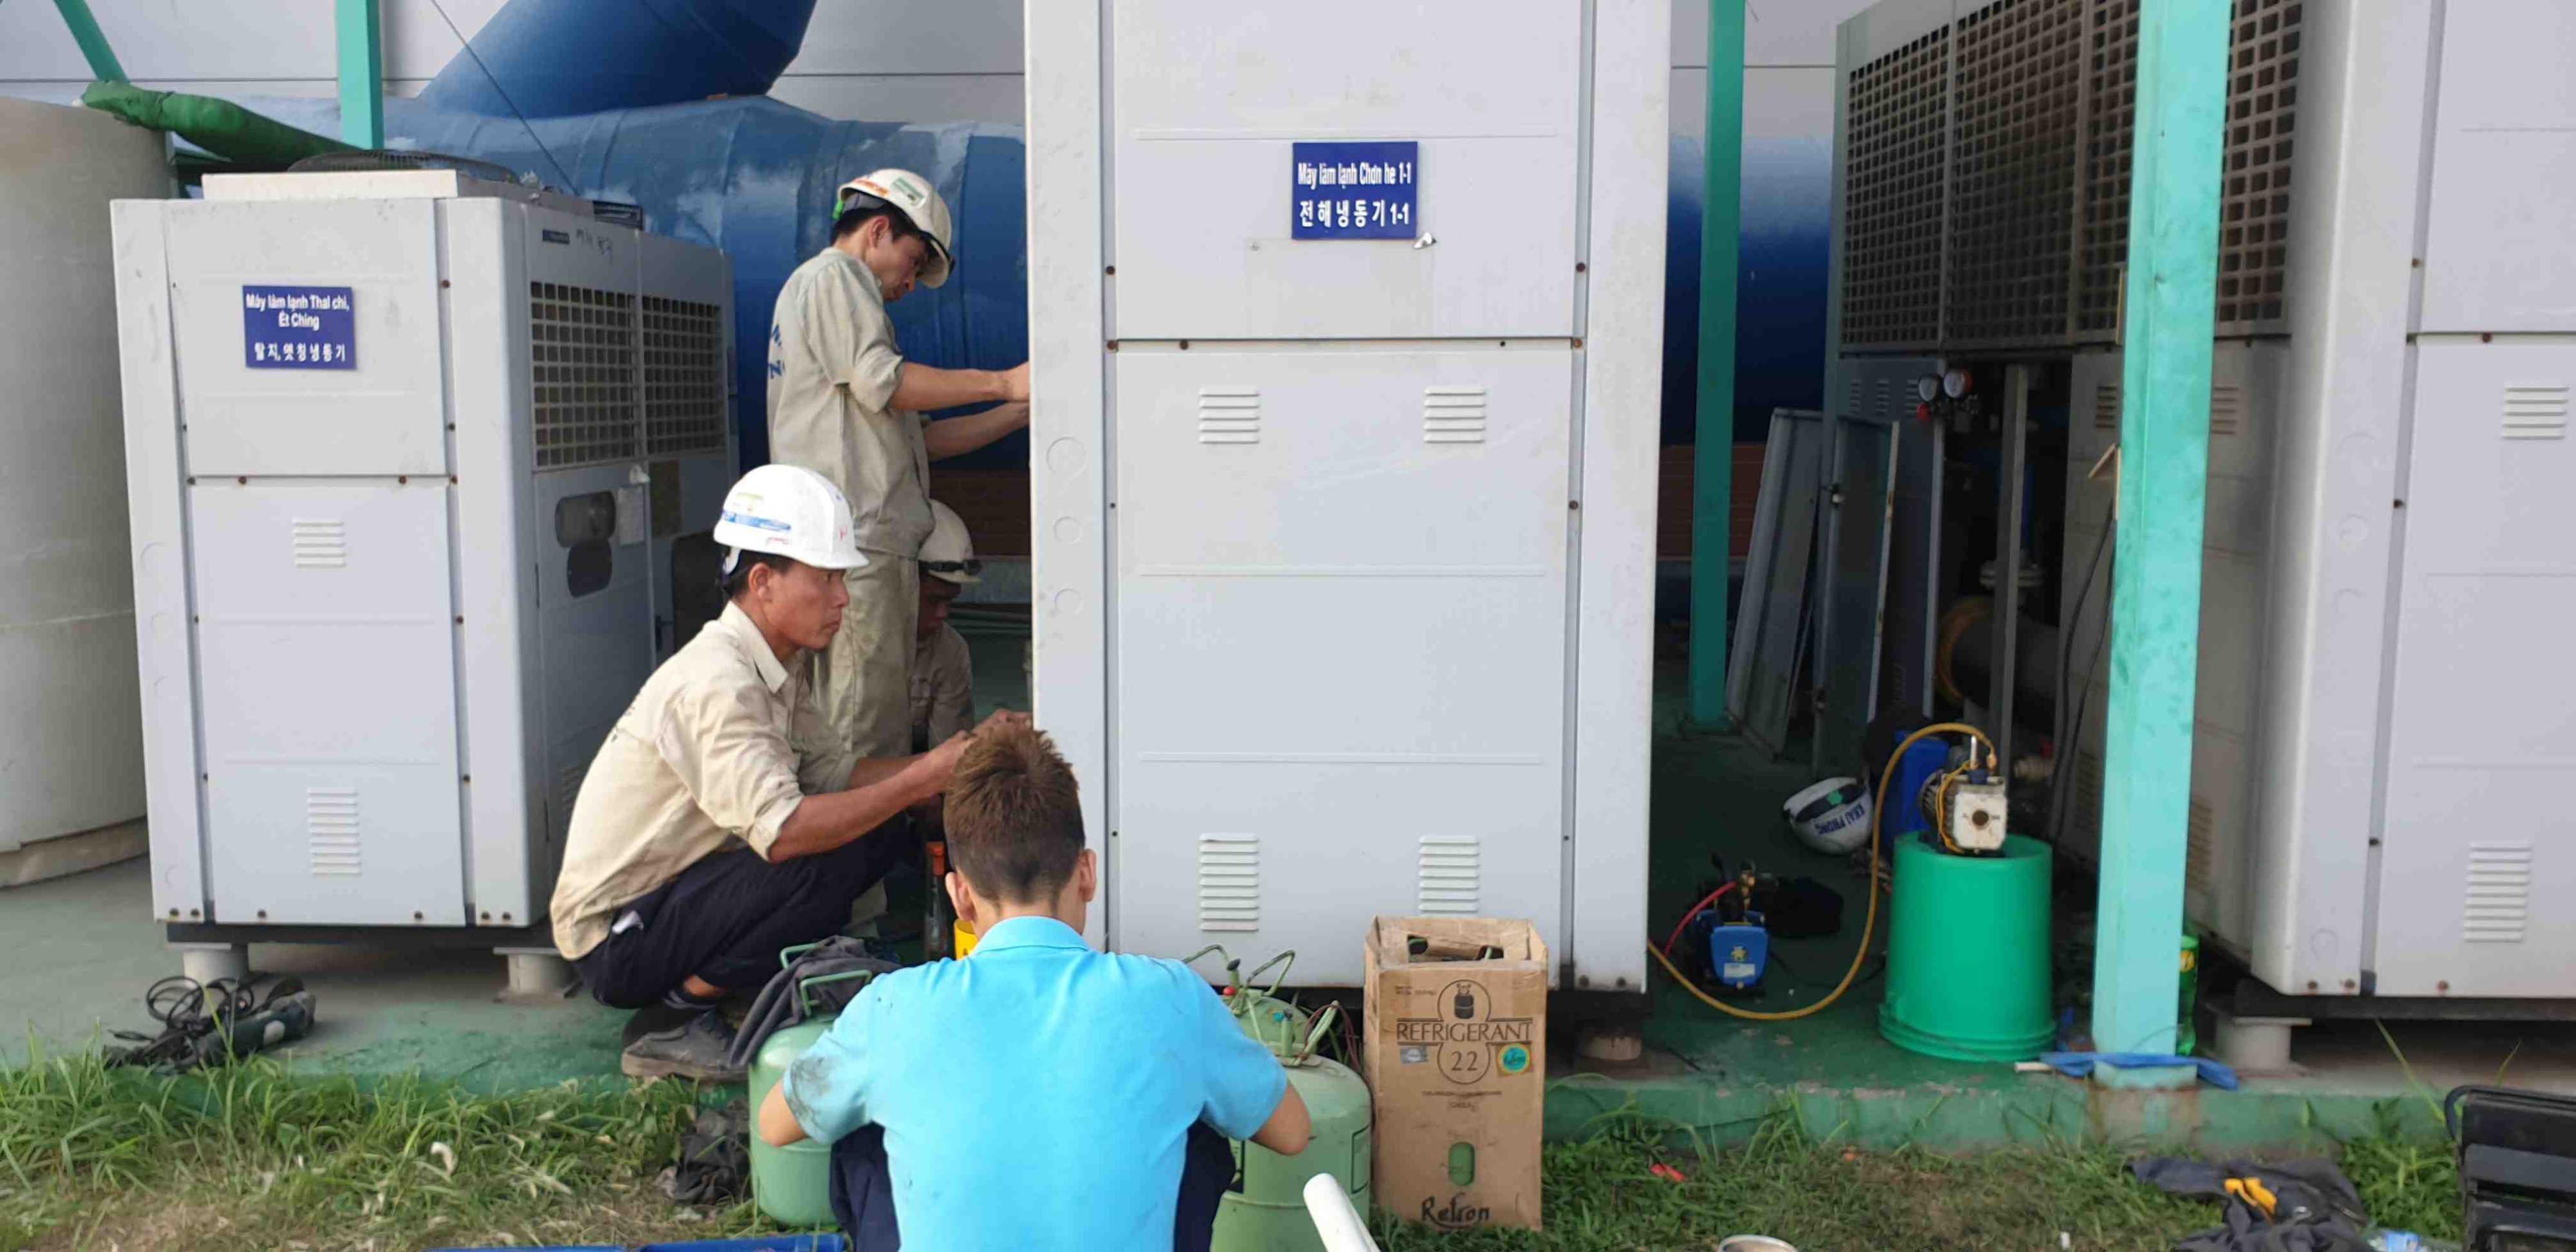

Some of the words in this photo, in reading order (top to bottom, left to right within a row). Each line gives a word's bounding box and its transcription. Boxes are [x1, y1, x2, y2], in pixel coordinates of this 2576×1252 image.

[1338, 162, 1358, 189] lạnh
[1385, 162, 1396, 184] he
[1399, 162, 1411, 184] 1-1
[1390, 203, 1409, 225] 1-1
[291, 312, 319, 331] Ching
[1396, 1021, 1533, 1043] REFRIGERANT
[1451, 1050, 1478, 1071] 22
